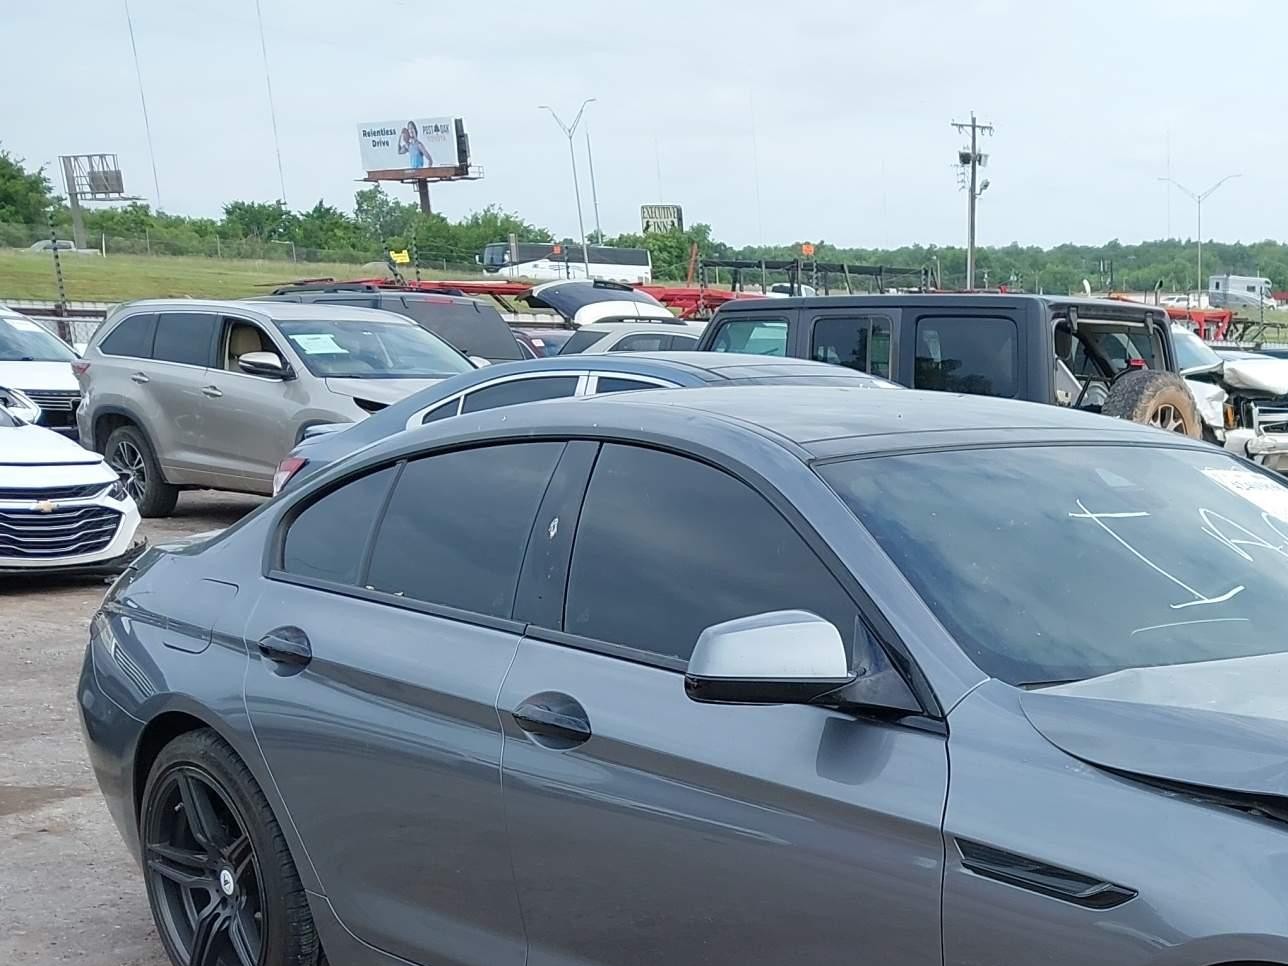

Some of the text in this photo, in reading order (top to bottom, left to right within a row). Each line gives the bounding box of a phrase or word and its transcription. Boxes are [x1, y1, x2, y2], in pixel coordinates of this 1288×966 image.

[362, 128, 396, 138] Relentless
[372, 140, 389, 148] Drive
[641, 206, 677, 219] EXECUTIVE
[653, 220, 670, 233] INN
